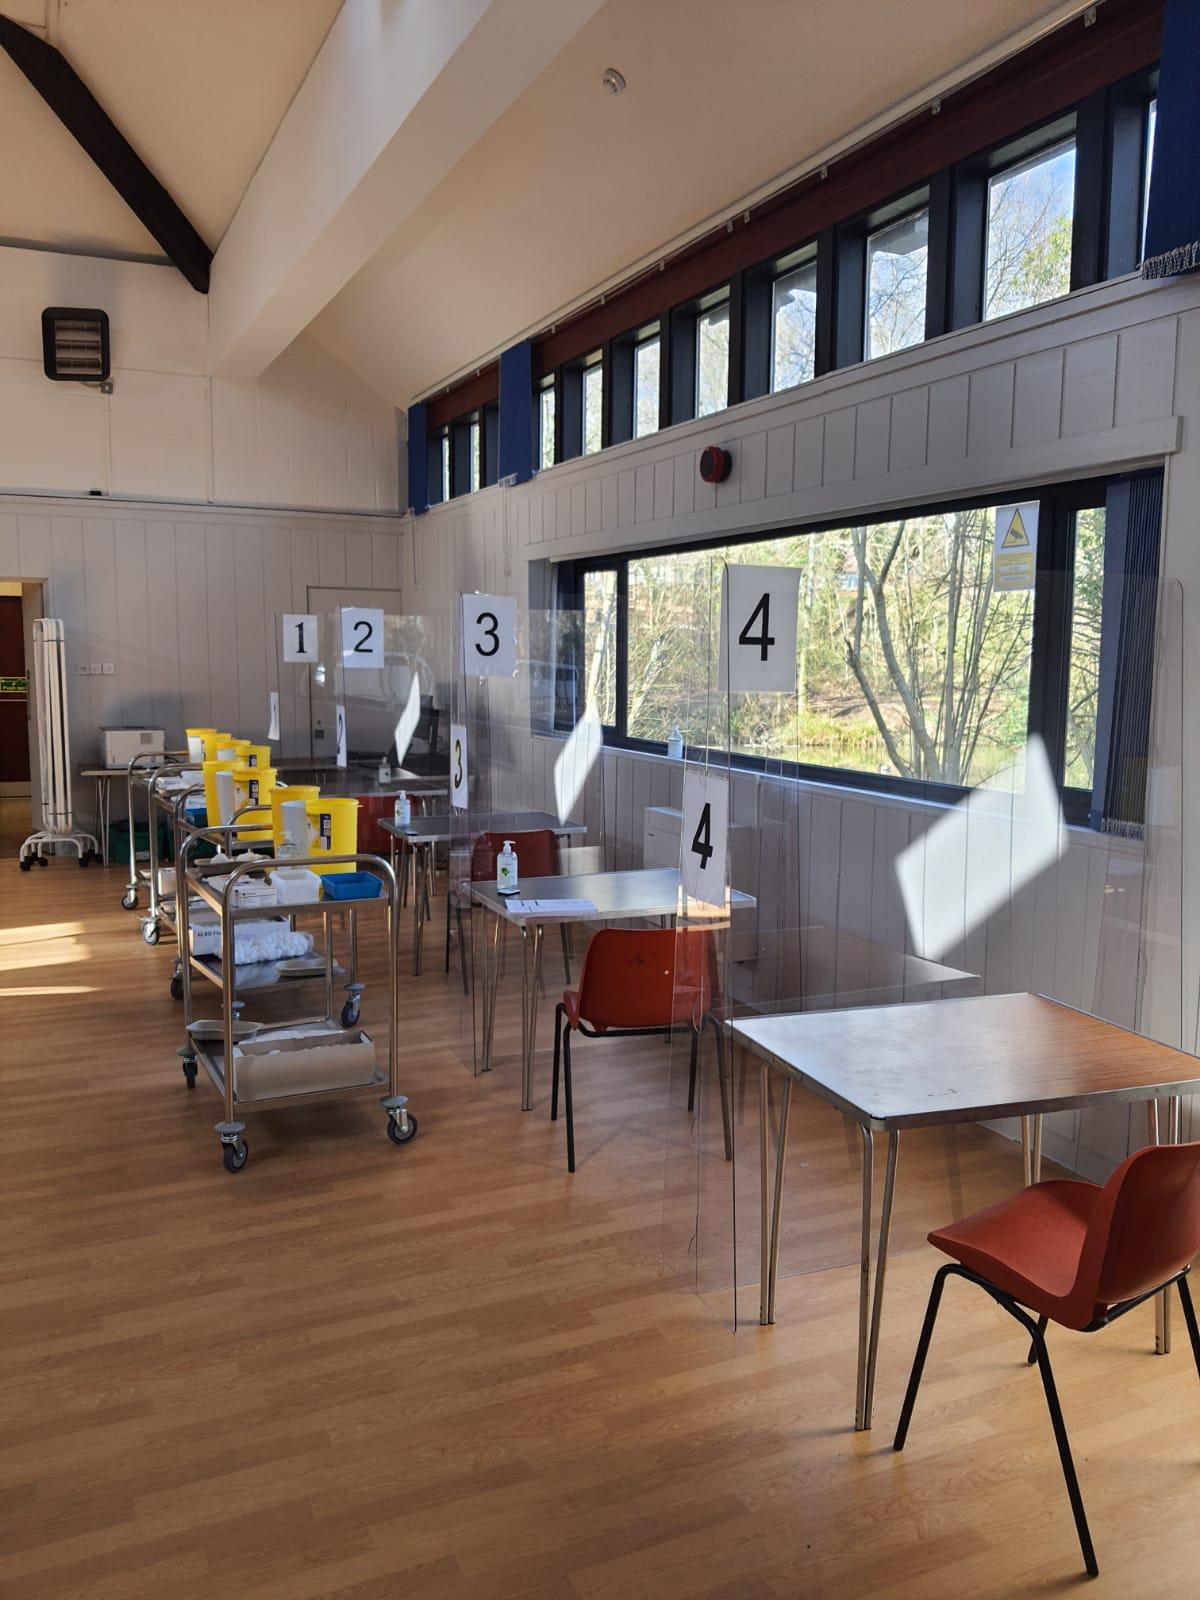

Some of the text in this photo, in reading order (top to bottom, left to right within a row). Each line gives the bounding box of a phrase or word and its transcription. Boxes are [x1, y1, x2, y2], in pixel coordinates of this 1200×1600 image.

[294, 621, 307, 654] 1
[353, 621, 374, 653] 2
[475, 612, 500, 657] 3
[738, 592, 775, 662] 4
[453, 739, 462, 789] 3
[691, 803, 713, 870] 4
